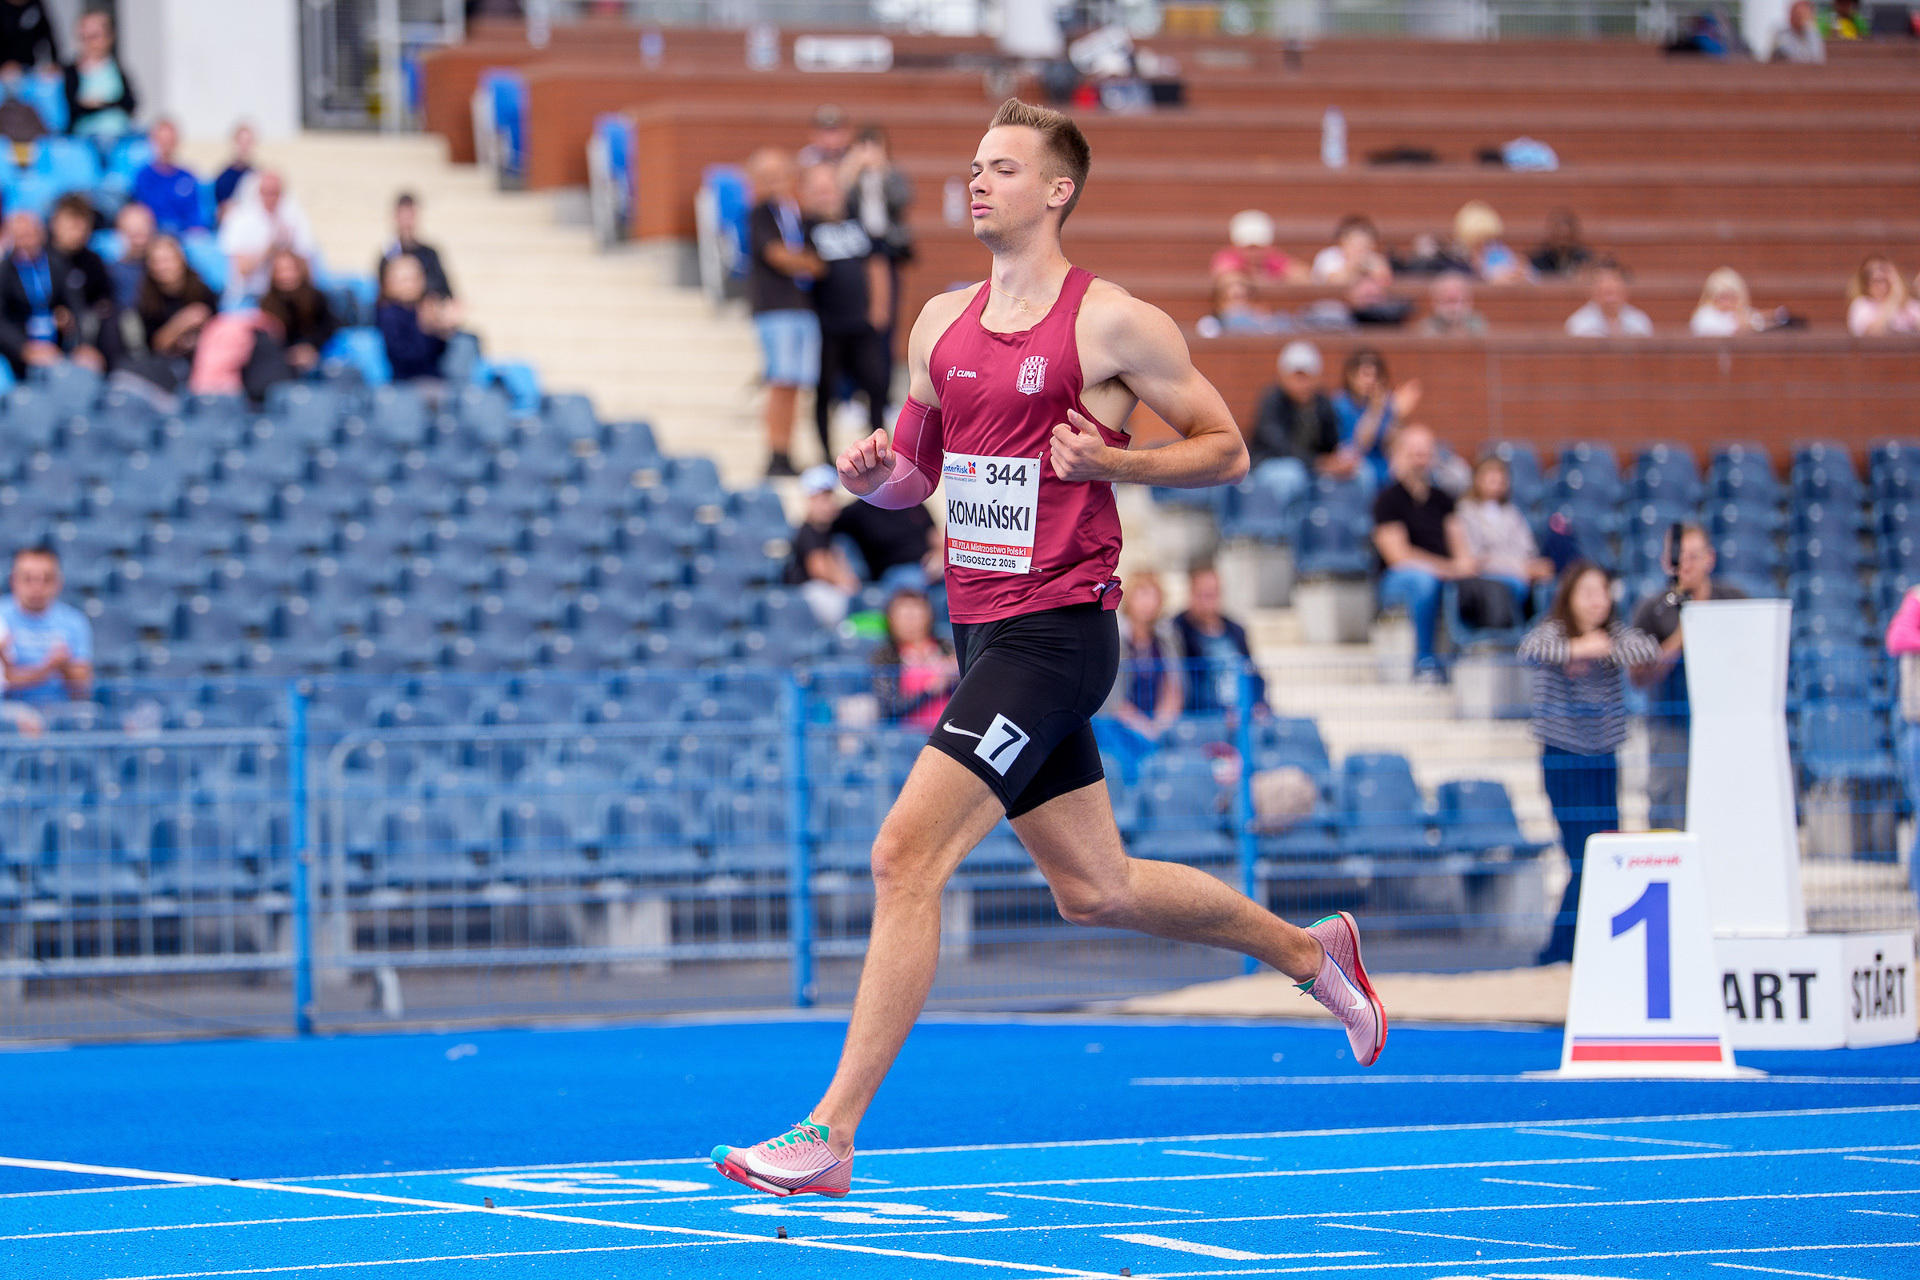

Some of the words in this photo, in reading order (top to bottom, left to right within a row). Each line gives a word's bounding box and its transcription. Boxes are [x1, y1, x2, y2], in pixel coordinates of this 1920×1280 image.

[943, 463, 969, 475] InterRisk
[986, 463, 1027, 487] 344
[948, 499, 1031, 531] KOMAŃSKI
[956, 553, 997, 567] BYDGOSZCZ
[998, 558, 1016, 569] 2025
[970, 543, 1007, 554] Mistrzostwa
[1006, 546, 1027, 556] Polski
[989, 722, 1023, 762] 7
[1610, 882, 1672, 1021] 1
